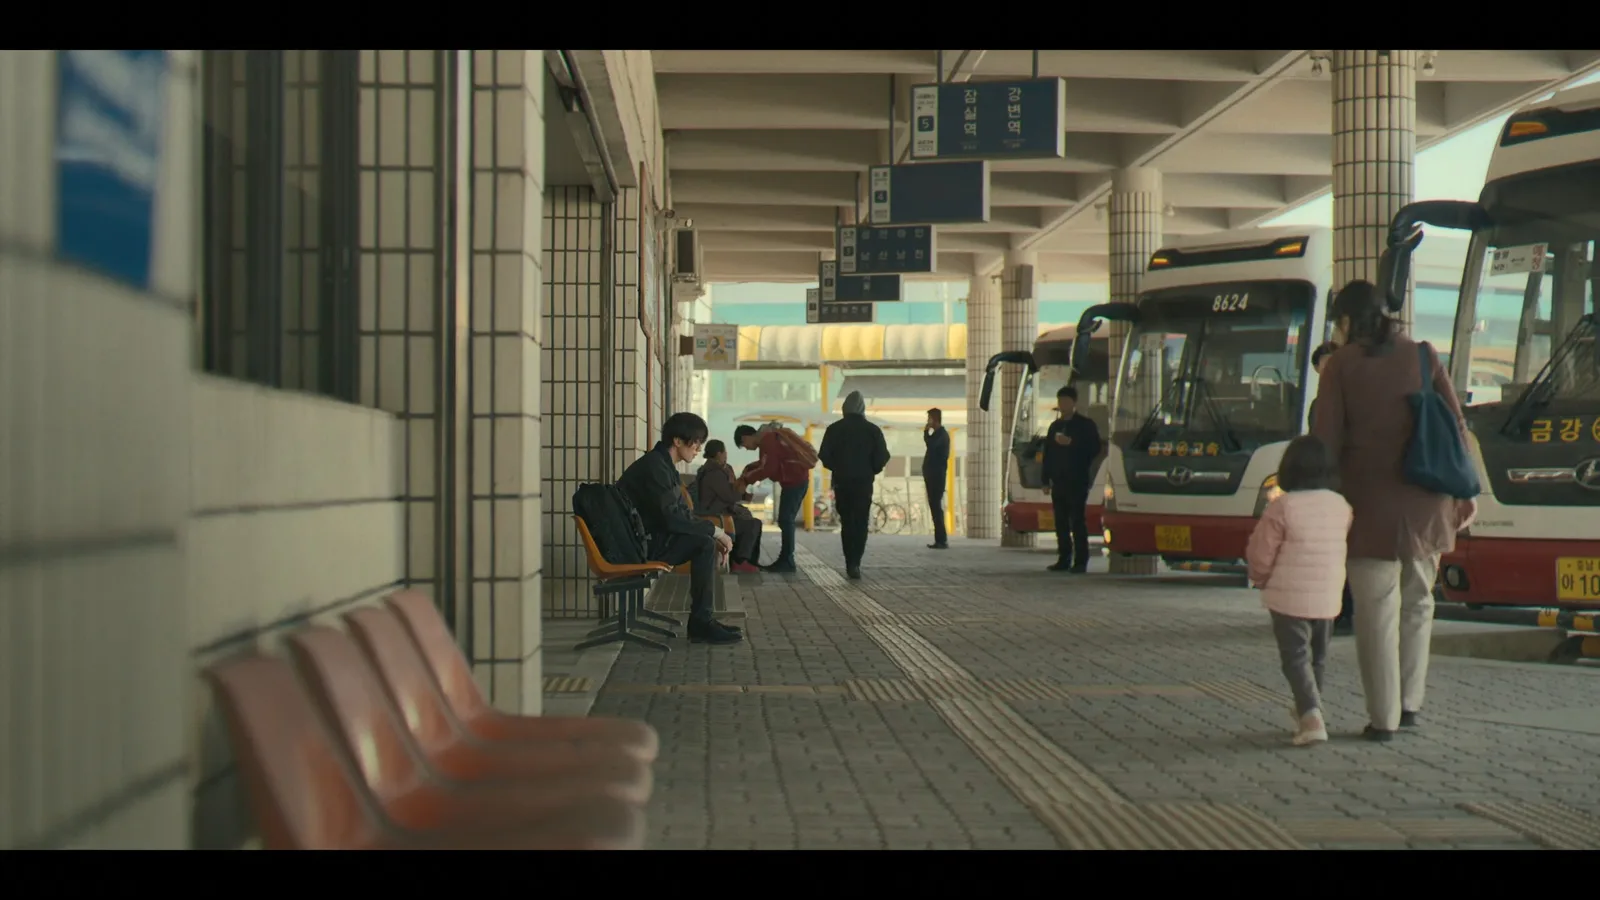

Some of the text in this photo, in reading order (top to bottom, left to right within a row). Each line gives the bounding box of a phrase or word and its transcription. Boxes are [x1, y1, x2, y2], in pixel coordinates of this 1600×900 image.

[964, 89, 978, 136] 잠실역
[1007, 87, 1022, 135] 강변역
[921, 118, 930, 129] 5
[1212, 292, 1249, 312] 8624
[1530, 416, 1584, 443] 금강
[1561, 573, 1575, 591] 아
